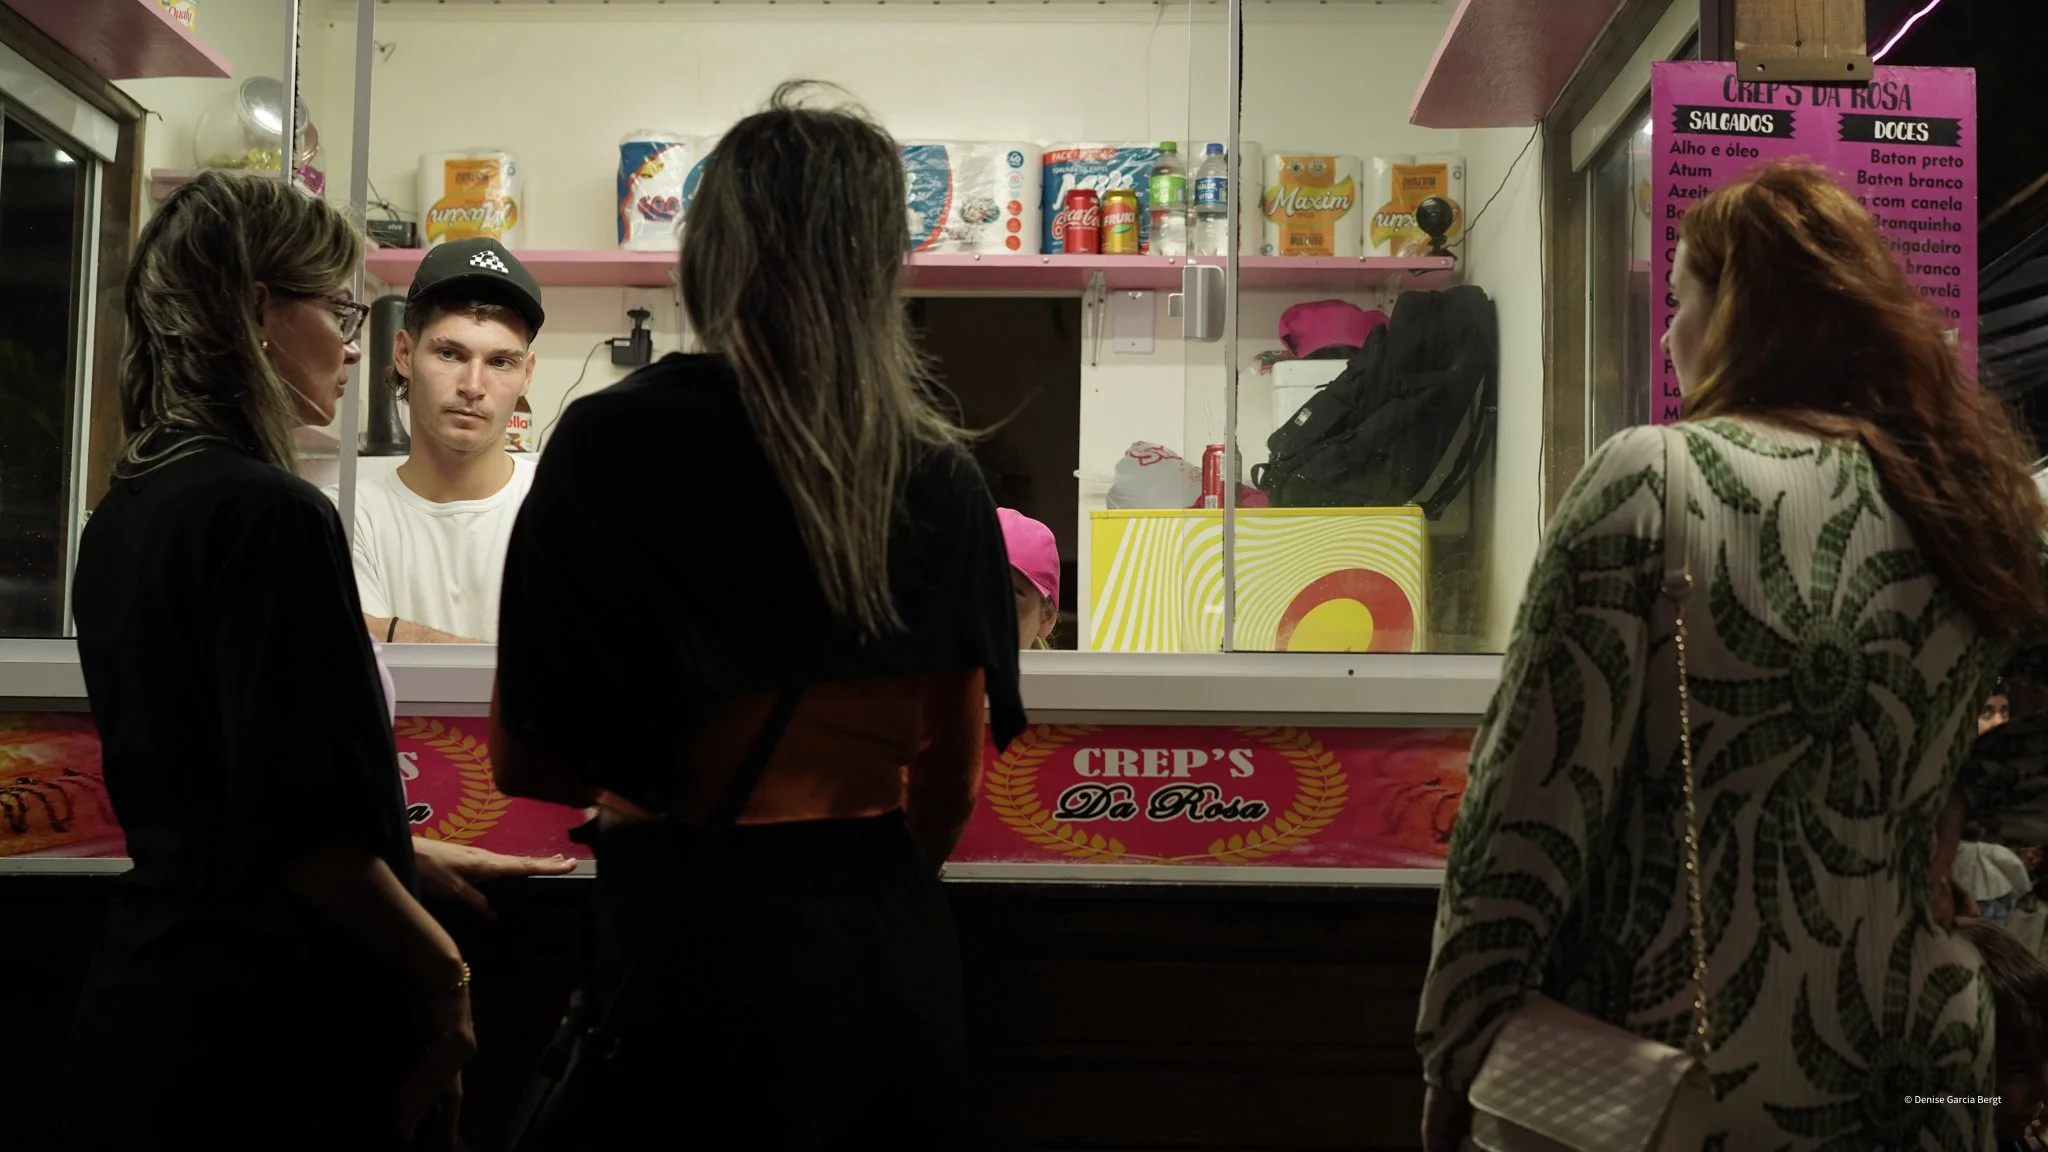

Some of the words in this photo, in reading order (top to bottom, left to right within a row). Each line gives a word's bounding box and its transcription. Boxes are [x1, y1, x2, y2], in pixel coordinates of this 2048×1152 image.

[1723, 74, 1802, 106] CREP'S
[1812, 86, 1841, 107] DA
[1851, 82, 1912, 111] ROSA
[1689, 110, 1774, 133] SALGADOS
[1874, 120, 1929, 142] DOCES
[1669, 140, 1706, 155] Alho
[1711, 145, 1720, 156] e
[1725, 142, 1759, 158] óleo
[1870, 149, 1916, 165] Baton
[1922, 155, 1964, 169] preto
[1669, 161, 1712, 177] Atum
[1857, 170, 1903, 186] Baton
[1909, 173, 1963, 189] branco
[1268, 185, 1350, 217] Maxim
[1668, 184, 1710, 199] Azeit
[1872, 197, 1905, 208] com
[1911, 196, 1963, 211] canela
[430, 200, 513, 232] Maxim
[1872, 214, 1962, 233] Branquinho
[1906, 259, 1961, 276] branco
[506, 415, 528, 429] ella
[1073, 748, 1255, 778] CREP'S
[1053, 782, 1140, 822] Da
[1146, 782, 1270, 823] Rosa
